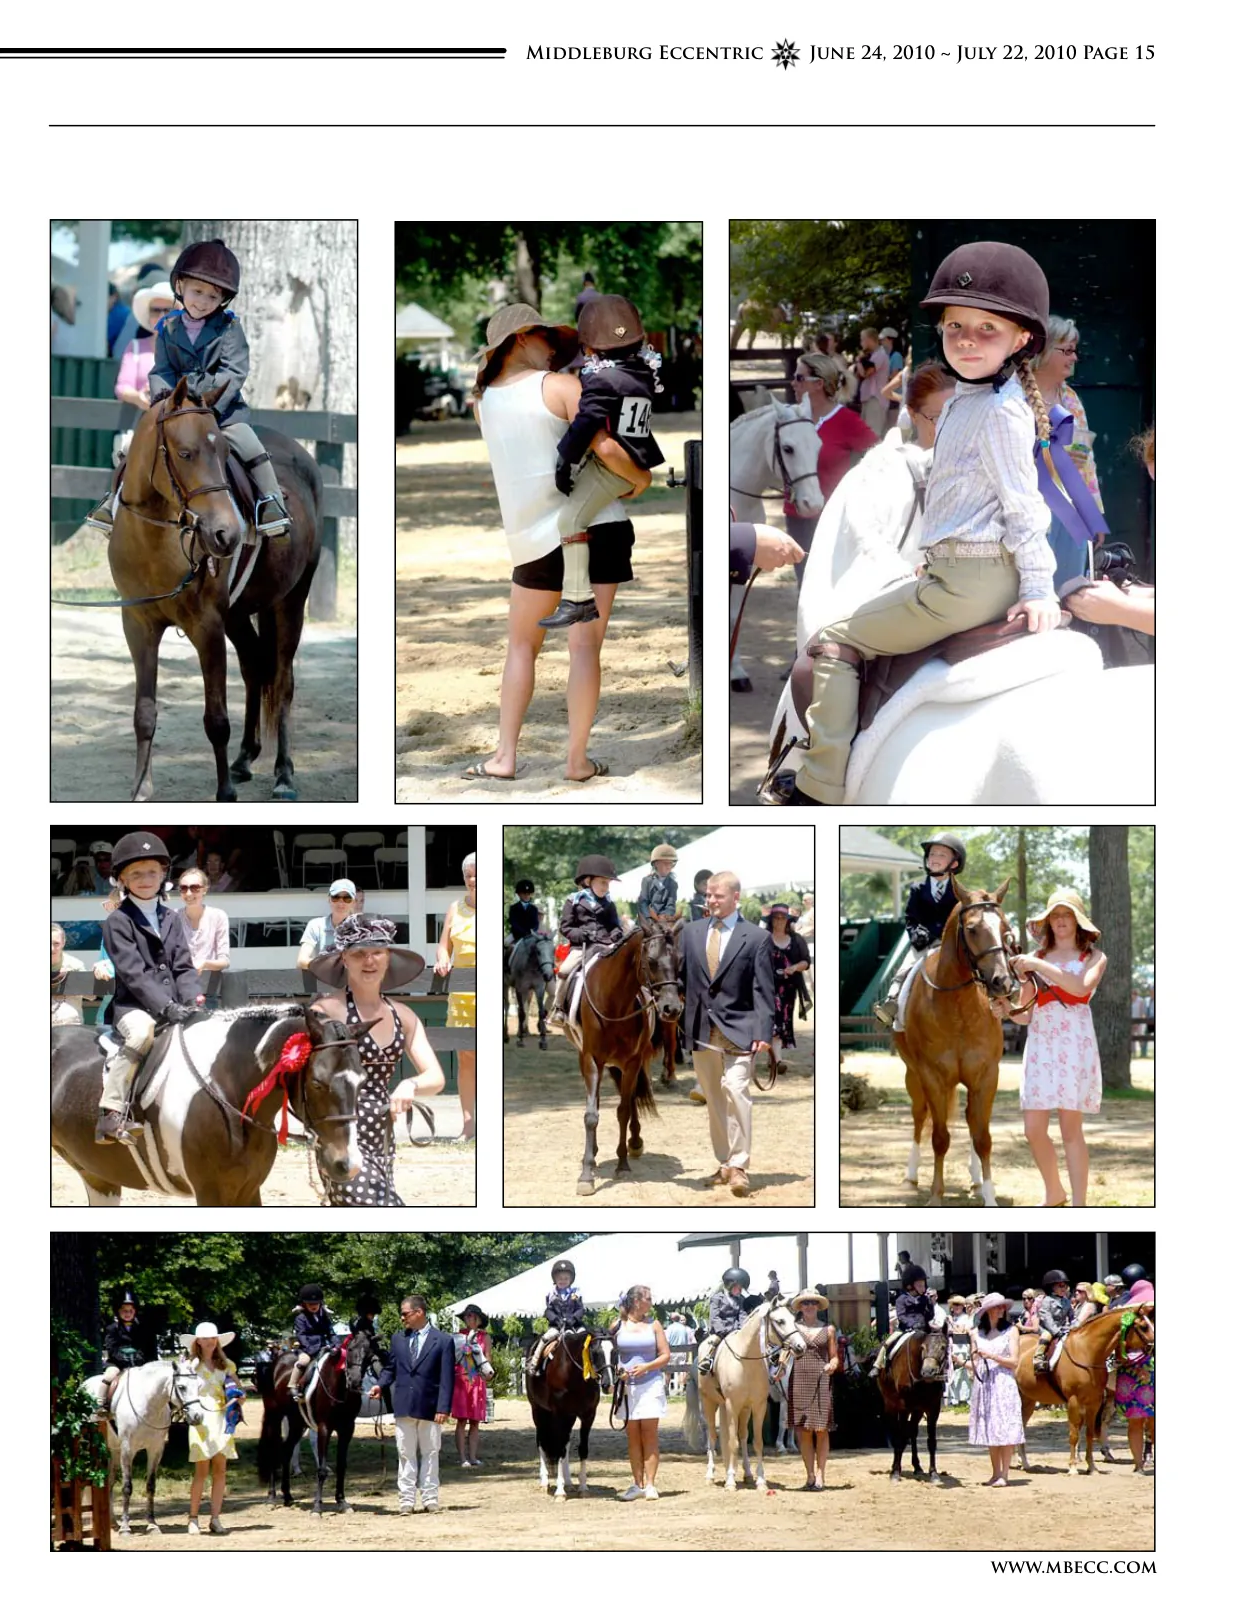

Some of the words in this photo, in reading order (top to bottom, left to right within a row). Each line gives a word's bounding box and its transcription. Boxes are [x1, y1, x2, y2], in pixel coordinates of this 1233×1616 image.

[526, 44, 652, 60] MIDDLEBURG
[659, 44, 764, 60] ECCENTRIC
[809, 44, 855, 64] JUNE
[861, 44, 887, 63] 24,
[892, 44, 936, 60] 2010
[956, 44, 998, 65] JULY
[1002, 44, 1028, 63] 22,
[1034, 44, 1077, 60] 2010
[1083, 44, 1129, 60] PAGE
[1135, 44, 1156, 60] 15
[626, 404, 651, 434] 14
